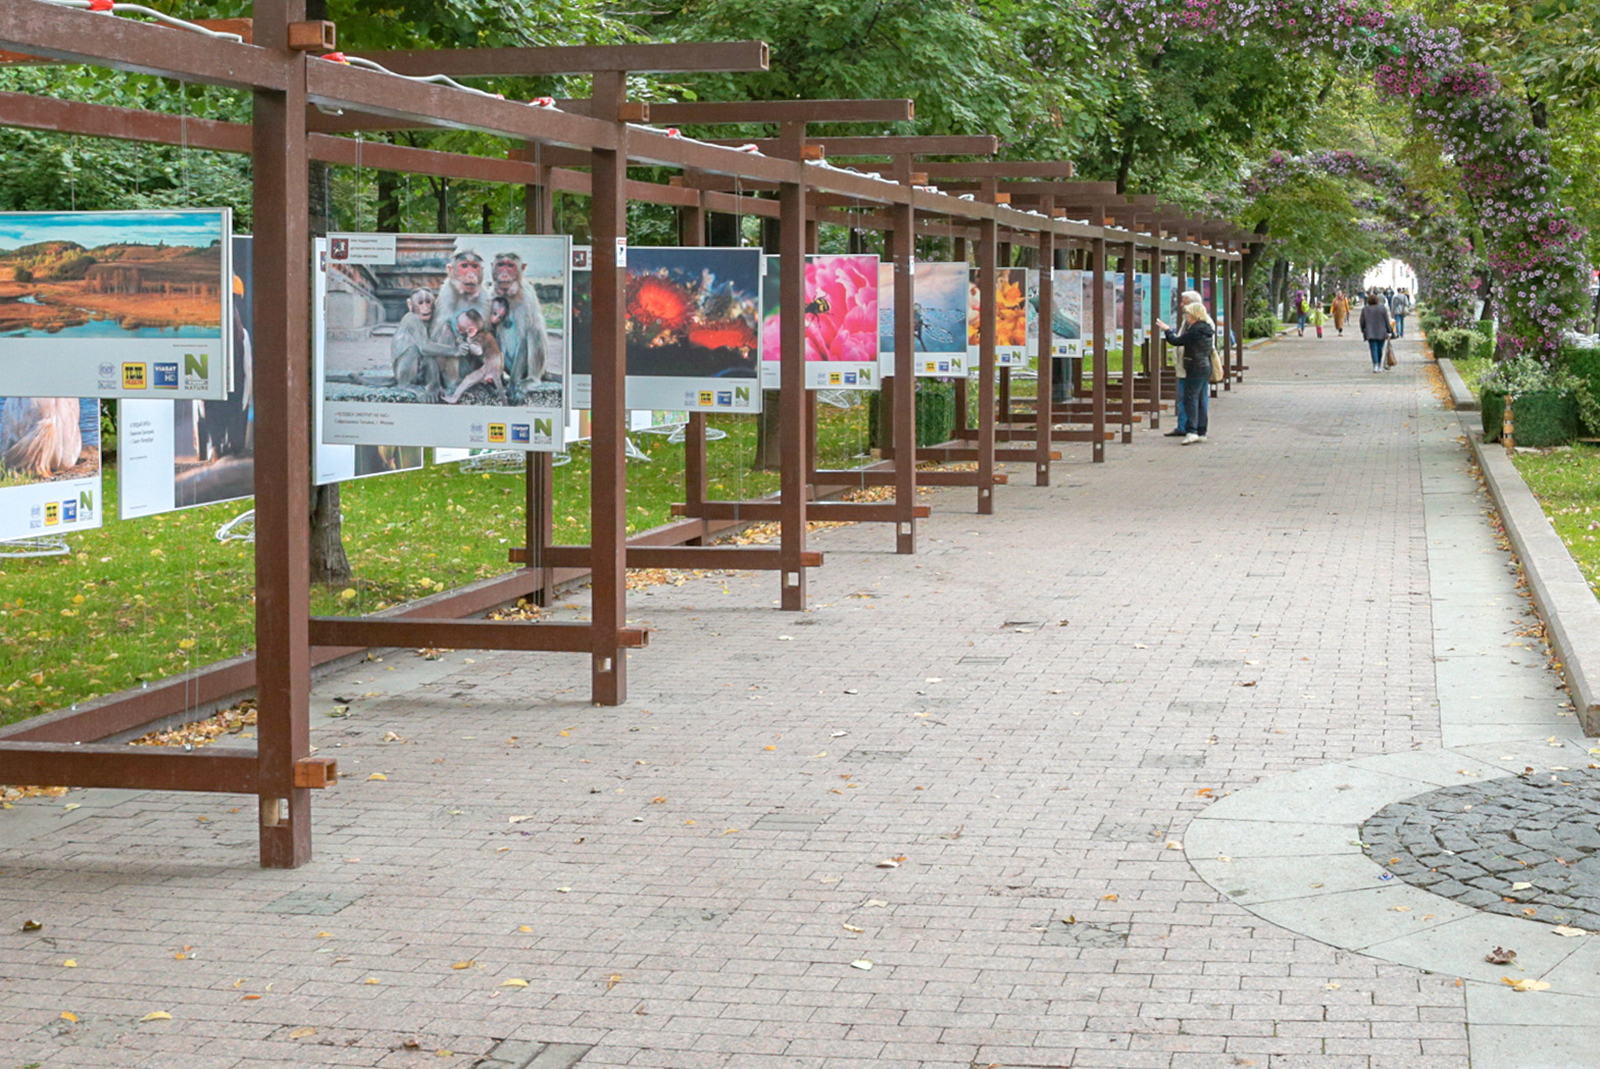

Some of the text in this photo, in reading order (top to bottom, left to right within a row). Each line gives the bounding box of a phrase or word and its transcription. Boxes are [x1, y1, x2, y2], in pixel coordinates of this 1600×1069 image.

[184, 353, 209, 380] N
[534, 418, 552, 437] N
[80, 490, 93, 511] N
